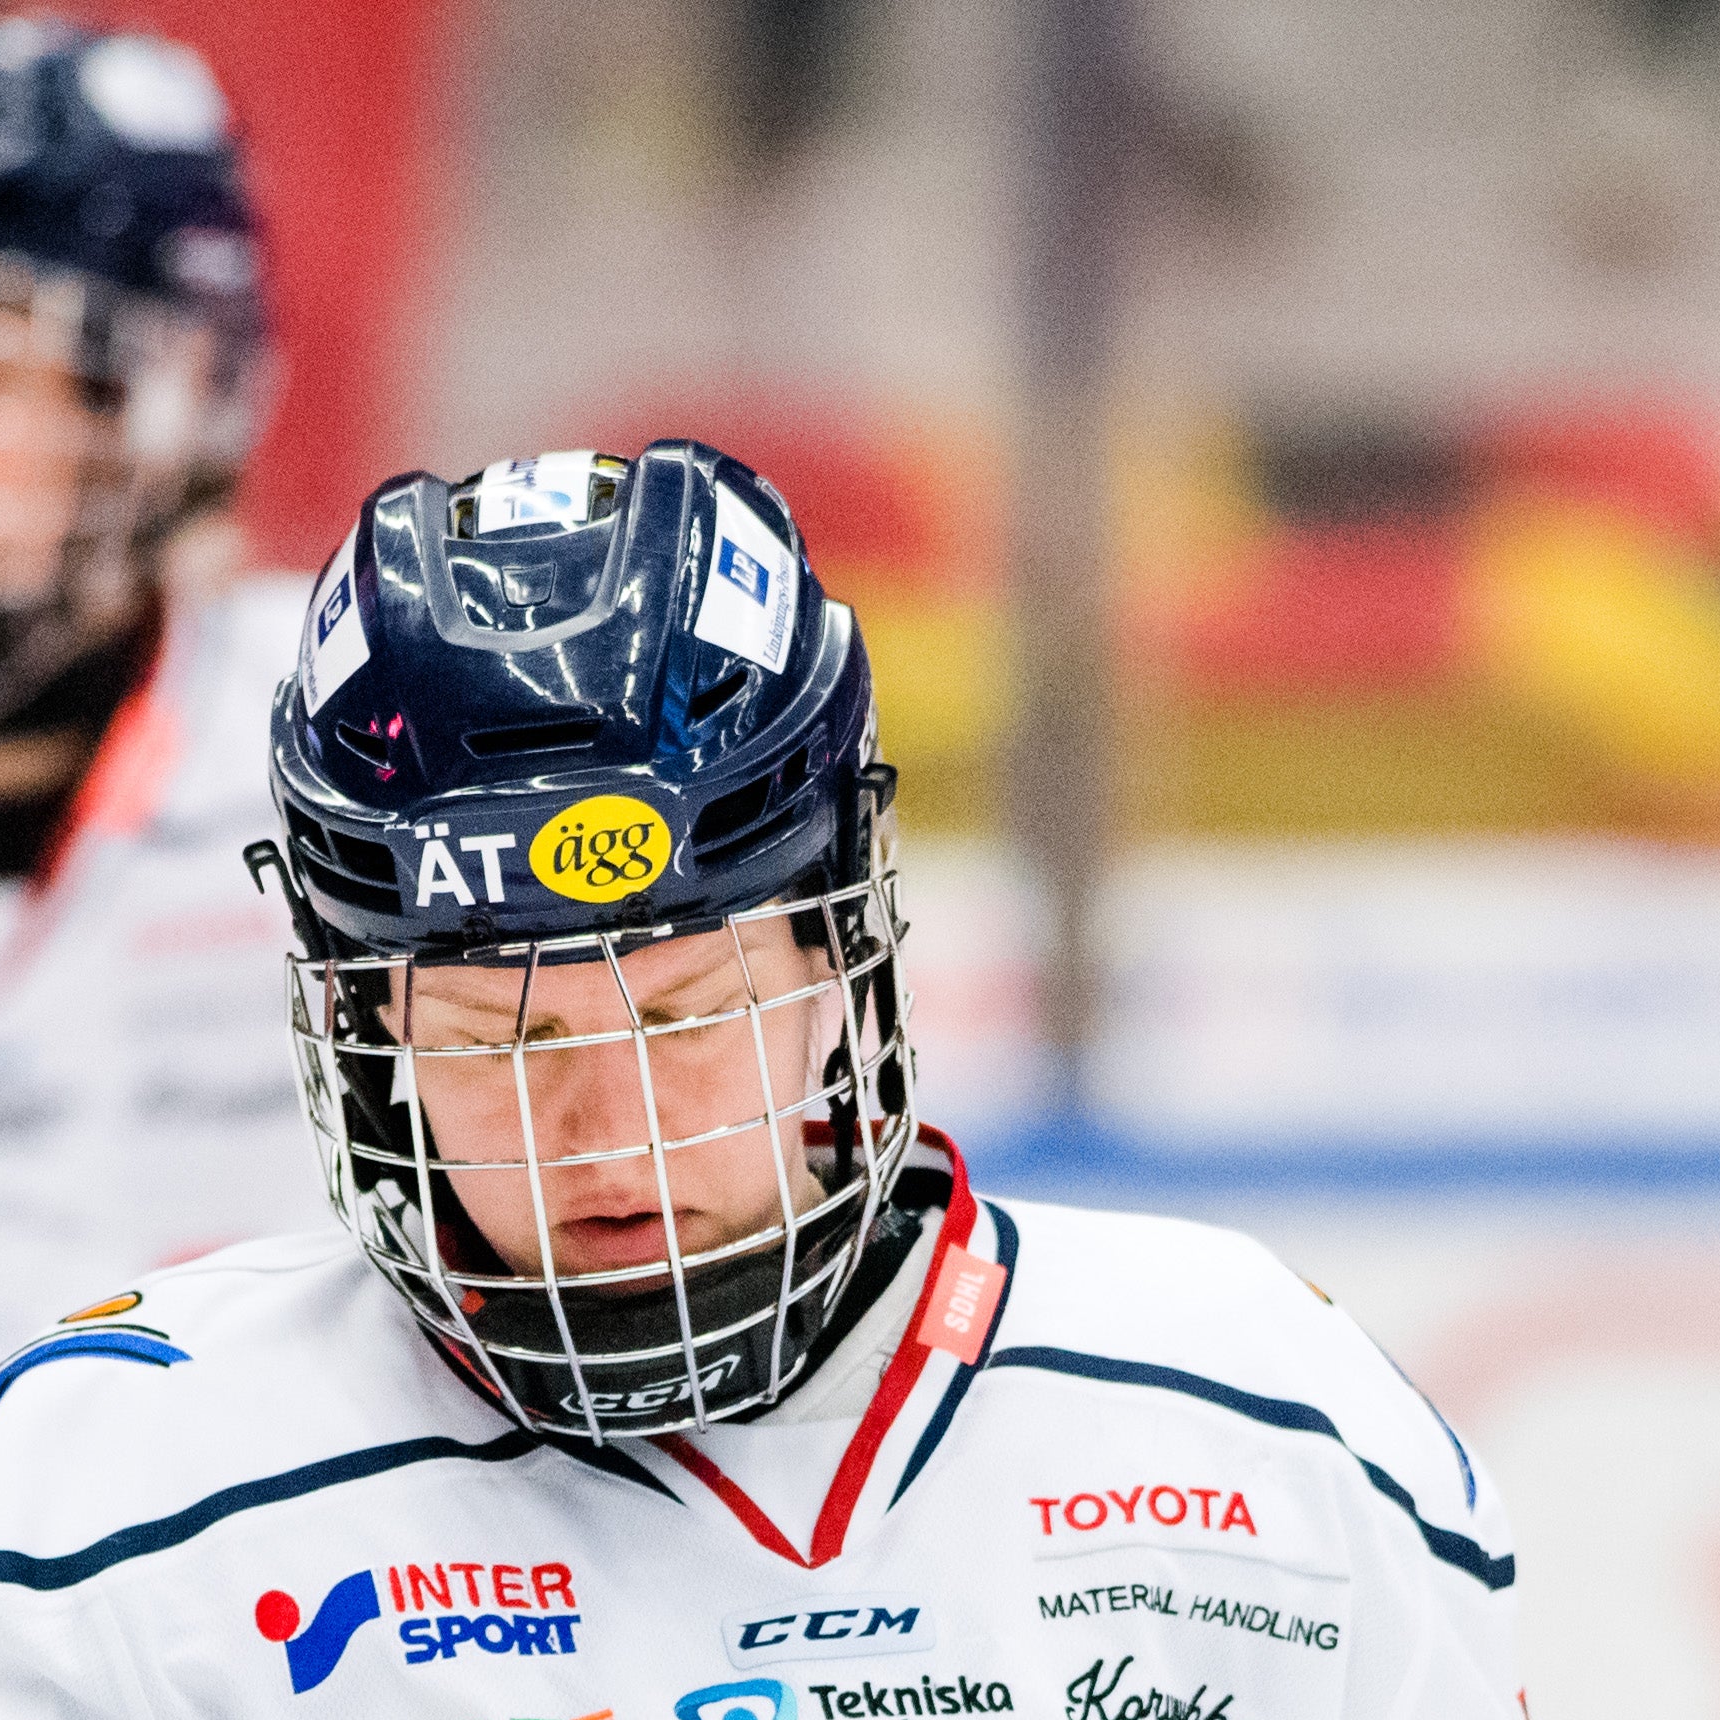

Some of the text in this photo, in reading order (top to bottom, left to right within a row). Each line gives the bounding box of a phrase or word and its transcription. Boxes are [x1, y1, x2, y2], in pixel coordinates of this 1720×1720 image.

[415, 822, 655, 907] ÄT ägg
[943, 1271, 986, 1334] SDHL
[1028, 1485, 1258, 1537] TOYOTA
[388, 1562, 577, 1613] INTER
[398, 1613, 581, 1665] SPORT
[738, 1607, 921, 1651] CCM
[1037, 1583, 1340, 1651] MATERIAL HANDLING
[808, 1675, 1015, 1720] Tekniska
